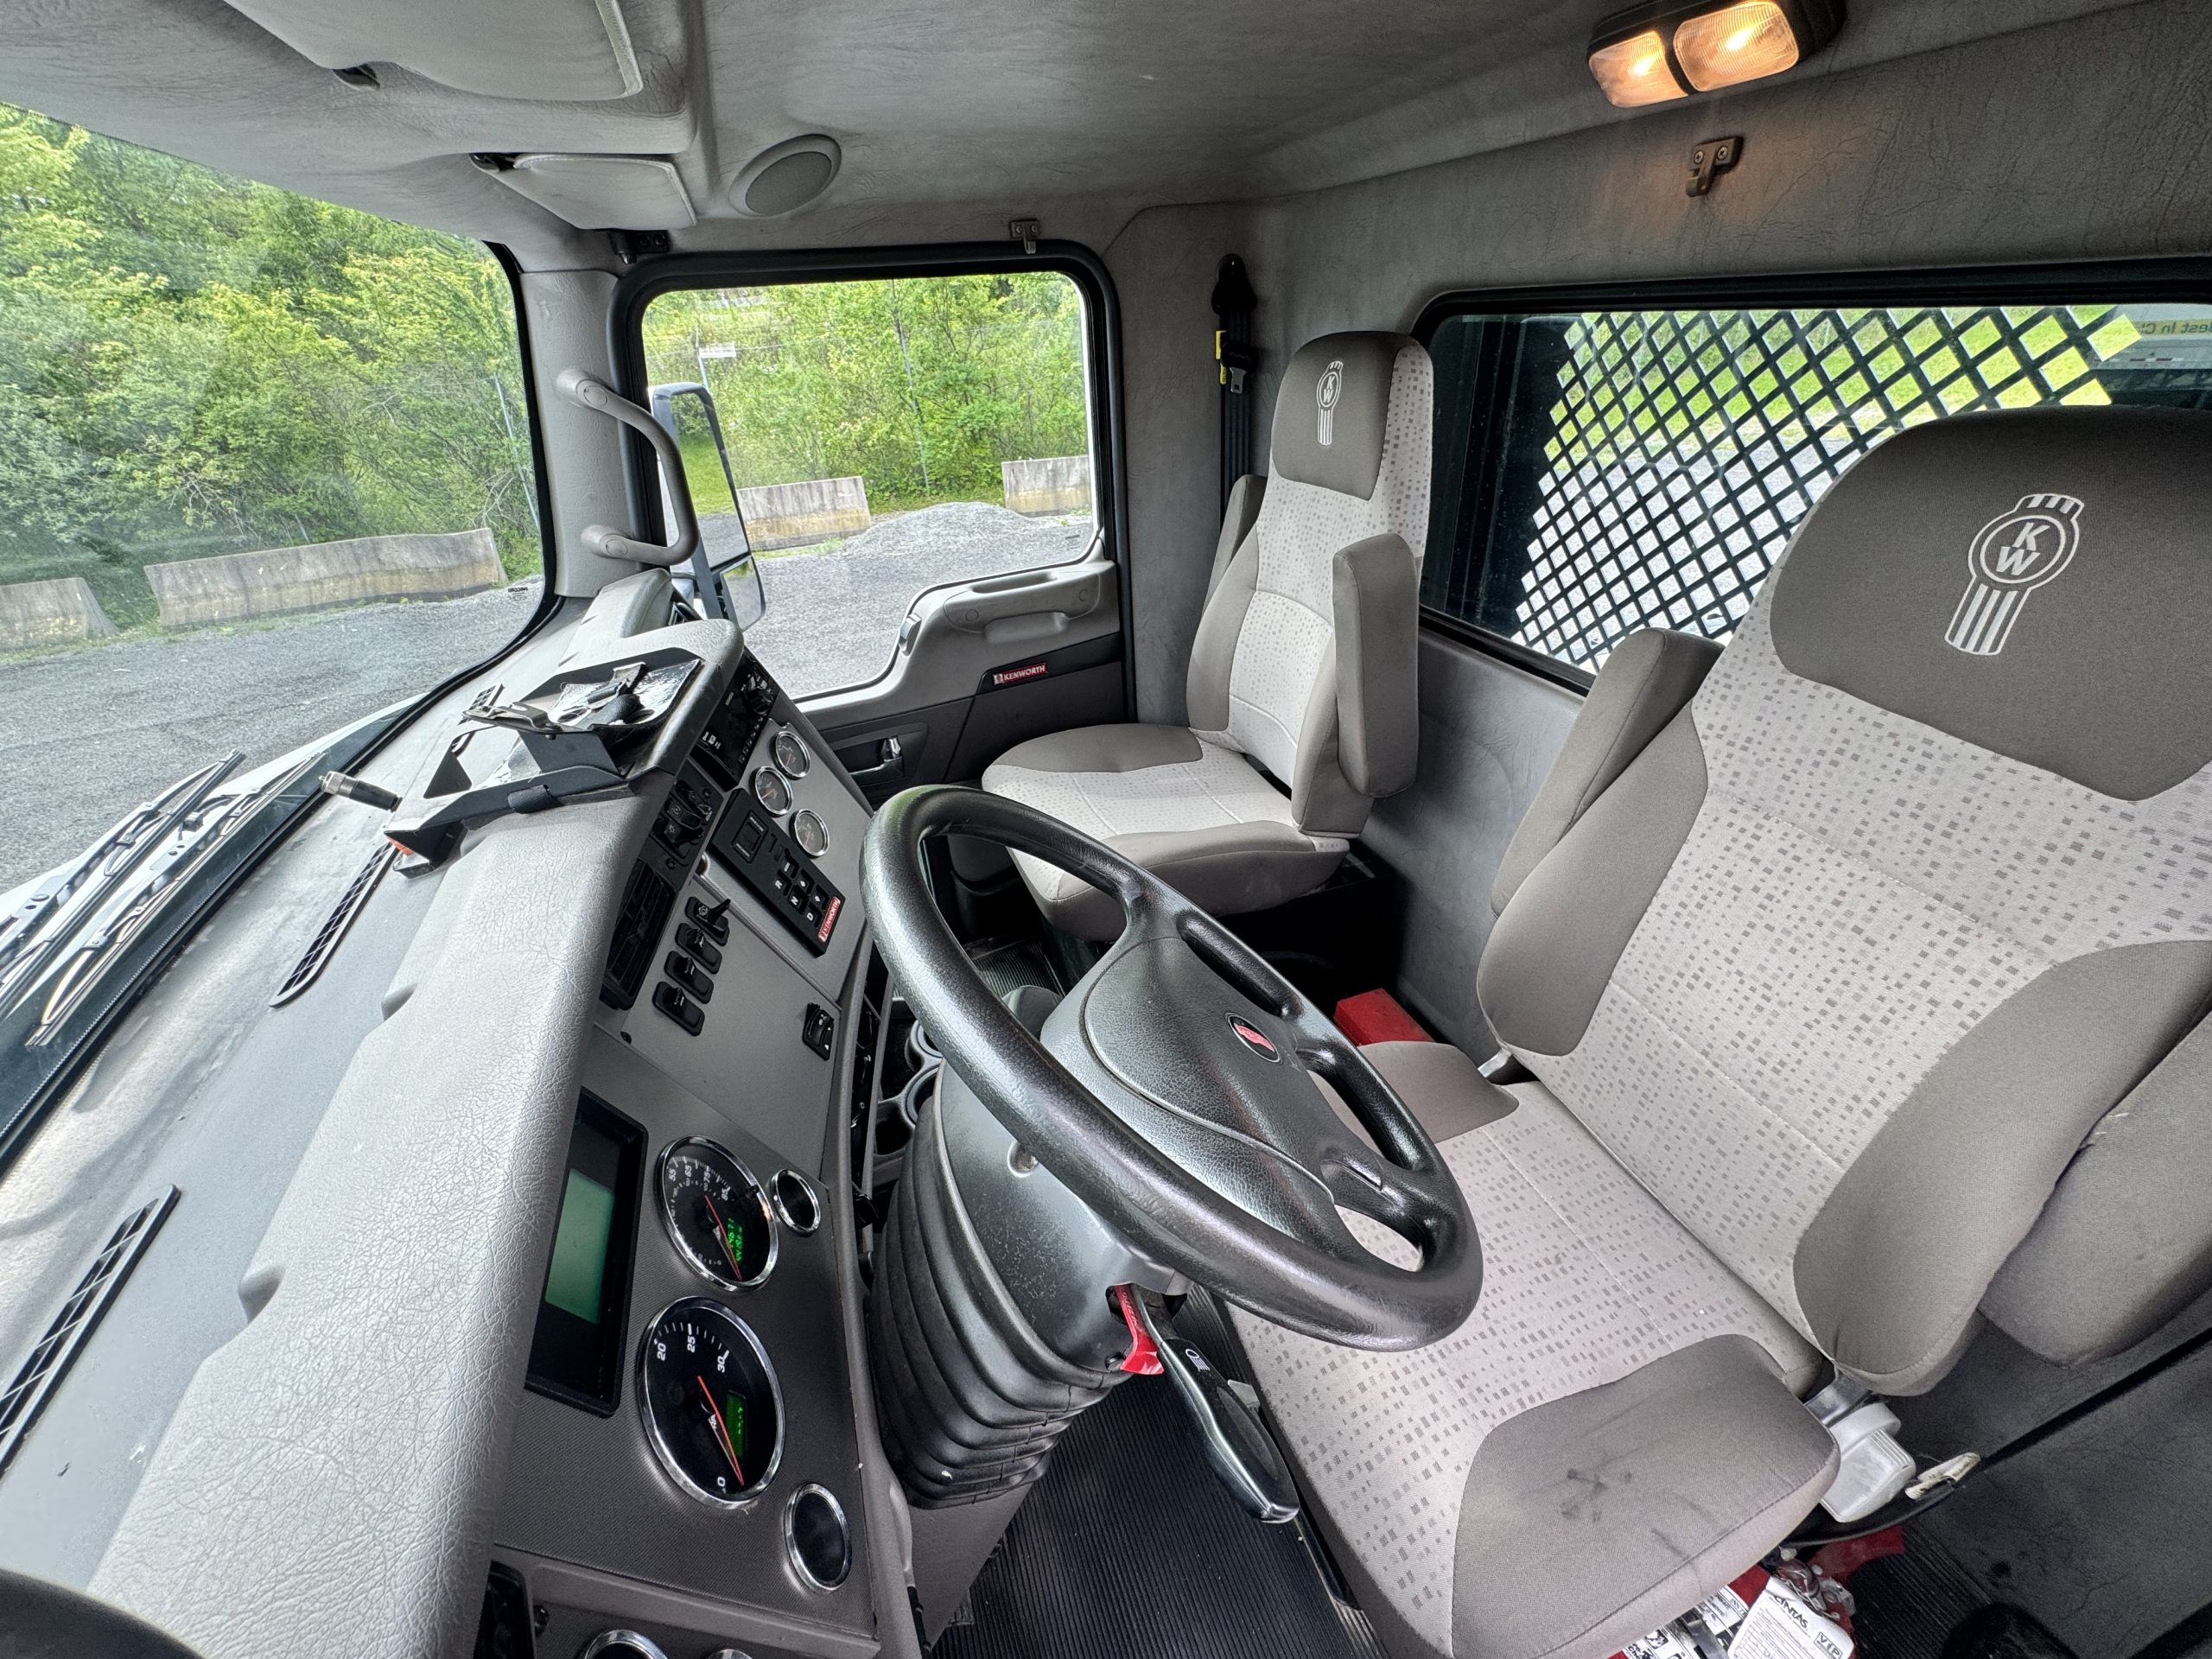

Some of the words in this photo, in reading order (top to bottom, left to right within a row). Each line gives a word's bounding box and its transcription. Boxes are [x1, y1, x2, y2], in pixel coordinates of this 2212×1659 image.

[1003, 664, 1046, 681] KENWORTH
[774, 880, 783, 890] R
[791, 896, 799, 906] N
[806, 912, 814, 921] D
[657, 1343, 667, 1361] 20
[687, 1336, 696, 1353] 25
[717, 1356, 727, 1373] 30
[1773, 1594, 1808, 1629] CINTAS
